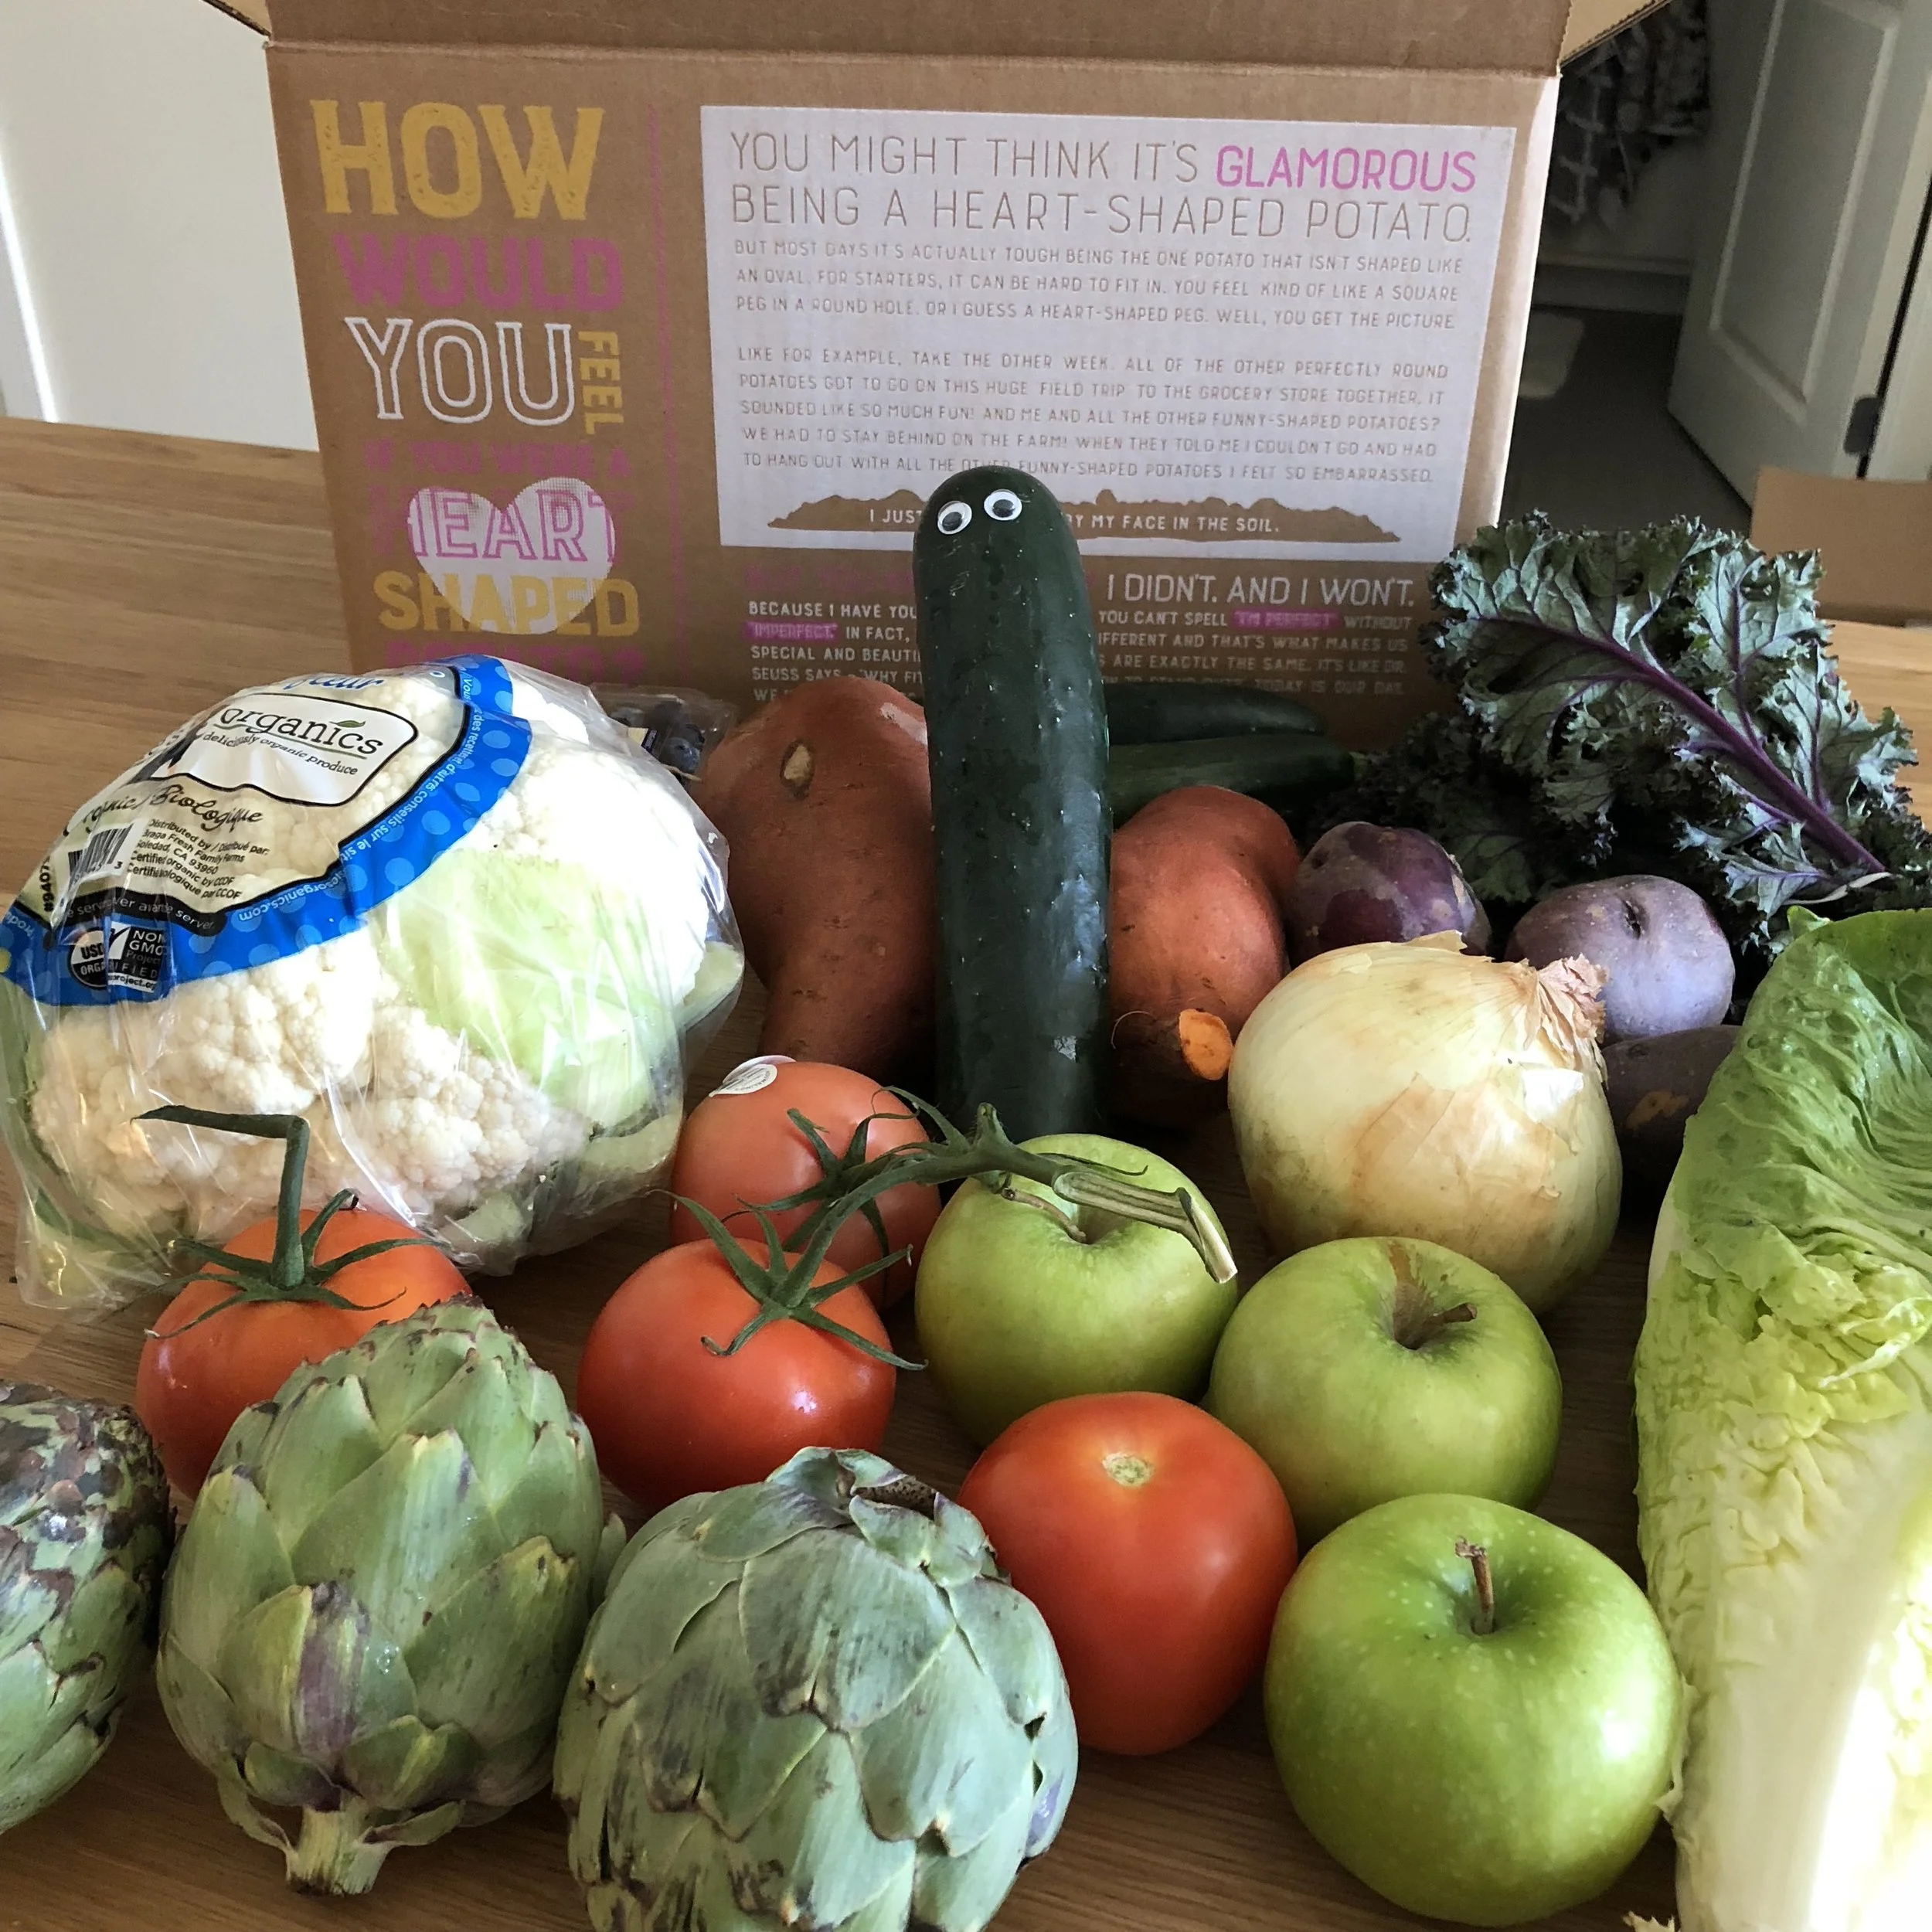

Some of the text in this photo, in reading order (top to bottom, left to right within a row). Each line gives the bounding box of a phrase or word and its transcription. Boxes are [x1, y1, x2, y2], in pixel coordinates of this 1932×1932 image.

[309, 100, 605, 220] HOW
[730, 132, 1475, 192] YOU MIGHT THINK IT'S GLAMOROUS
[733, 185, 1470, 242] BEING A HEART-SHAPED POTATO.
[332, 233, 623, 311] WOULD
[734, 238, 1462, 276] BUT MOST DAYS ACTUALLY TOUGH BEING THE ONE POTATO THAT SHAPED LIKE
[736, 268, 757, 287] AN
[818, 270, 847, 289] FOR
[855, 271, 942, 291] STARTERS,
[949, 274, 963, 291] IT
[971, 274, 1004, 293] CAN
[1010, 274, 1029, 293] BE
[1037, 275, 1082, 294] HARD
[1090, 277, 1110, 295] TO
[1116, 277, 1138, 296] FIT
[1175, 278, 1206, 298] YOU
[1213, 280, 1248, 298] FEEL
[1261, 281, 1300, 300] KIND
[1306, 281, 1325, 301] OF
[1333, 282, 1367, 301] LIKE
[1375, 283, 1383, 302] A
[1393, 284, 1458, 304] SQUARE
[736, 295, 766, 315] PEG
[773, 296, 787, 315] IN
[795, 297, 804, 315] A
[812, 297, 867, 317] ROUND
[926, 300, 946, 319] OR
[963, 301, 1016, 321] GUESS
[1024, 302, 1033, 321] A
[1041, 303, 1168, 325] HEART-SHAPED
[1274, 308, 1305, 328] YOU
[1312, 309, 1342, 329] GET
[1351, 311, 1379, 330] THE
[344, 317, 624, 436] YOU FEEL
[738, 345, 772, 365] LIKE
[783, 346, 811, 366] FOR
[913, 349, 951, 369] TAKE
[963, 351, 991, 370] THE
[1002, 352, 1052, 372] OTHER
[1125, 354, 1154, 374] ALL
[1165, 355, 1182, 375] OF
[1195, 355, 1223, 376] THE
[1234, 357, 1284, 378] OTHER
[1295, 358, 1380, 380] PERFECTLY
[1393, 360, 1448, 382] ROUND
[739, 372, 1444, 408] POTATOES GOT TO GO ON THIS HUGE FIELD TRIP TO THE GROCERY STORE IT
[739, 399, 816, 419] SOUNDED
[823, 401, 855, 420] LIKE
[860, 402, 882, 421] SO
[886, 403, 933, 422] MUCH
[983, 405, 1015, 424] AND
[1021, 406, 1040, 425] ME
[1048, 406, 1080, 426] AND
[1087, 407, 1114, 427] ALL
[1122, 409, 1150, 427] THE
[1157, 410, 1206, 429] OTHER
[1213, 410, 1341, 433] FUNNY-SHAPED
[1348, 414, 1440, 435] POTATOES?
[1090, 515, 1114, 529] MY
[1121, 515, 1165, 531] FACE
[1172, 516, 1189, 531] IN
[1196, 516, 1228, 532] THE
[1236, 517, 1278, 532] SOIL.
[373, 570, 641, 637] SHAPED
[1107, 573, 1413, 608] I DIDN'T. AND I WON'T.
[748, 601, 881, 618] BECAUSE HAVE
[1098, 610, 1128, 624] YOU
[1133, 611, 1178, 625] CAN'T
[1184, 612, 1227, 627] SPELL
[845, 626, 910, 644] IN FACT,
[1172, 634, 1204, 648] AND
[1211, 634, 1264, 650] THAT'S
[1272, 635, 1318, 651] WHAT
[1325, 636, 1380, 651] MAKES
[750, 645, 855, 662] SPECIAL AND
[1113, 655, 1142, 669] ARE
[1149, 655, 1218, 670] EXACTLY
[1226, 656, 1255, 671] THE
[751, 666, 800, 682] SEUSS
[220, 708, 383, 755] organics
[260, 738, 358, 775] organic produce
[387, 790, 428, 827] conseils
[168, 833, 194, 852] Fresh
[198, 839, 211, 850] by
[173, 848, 219, 875] CA 93960
